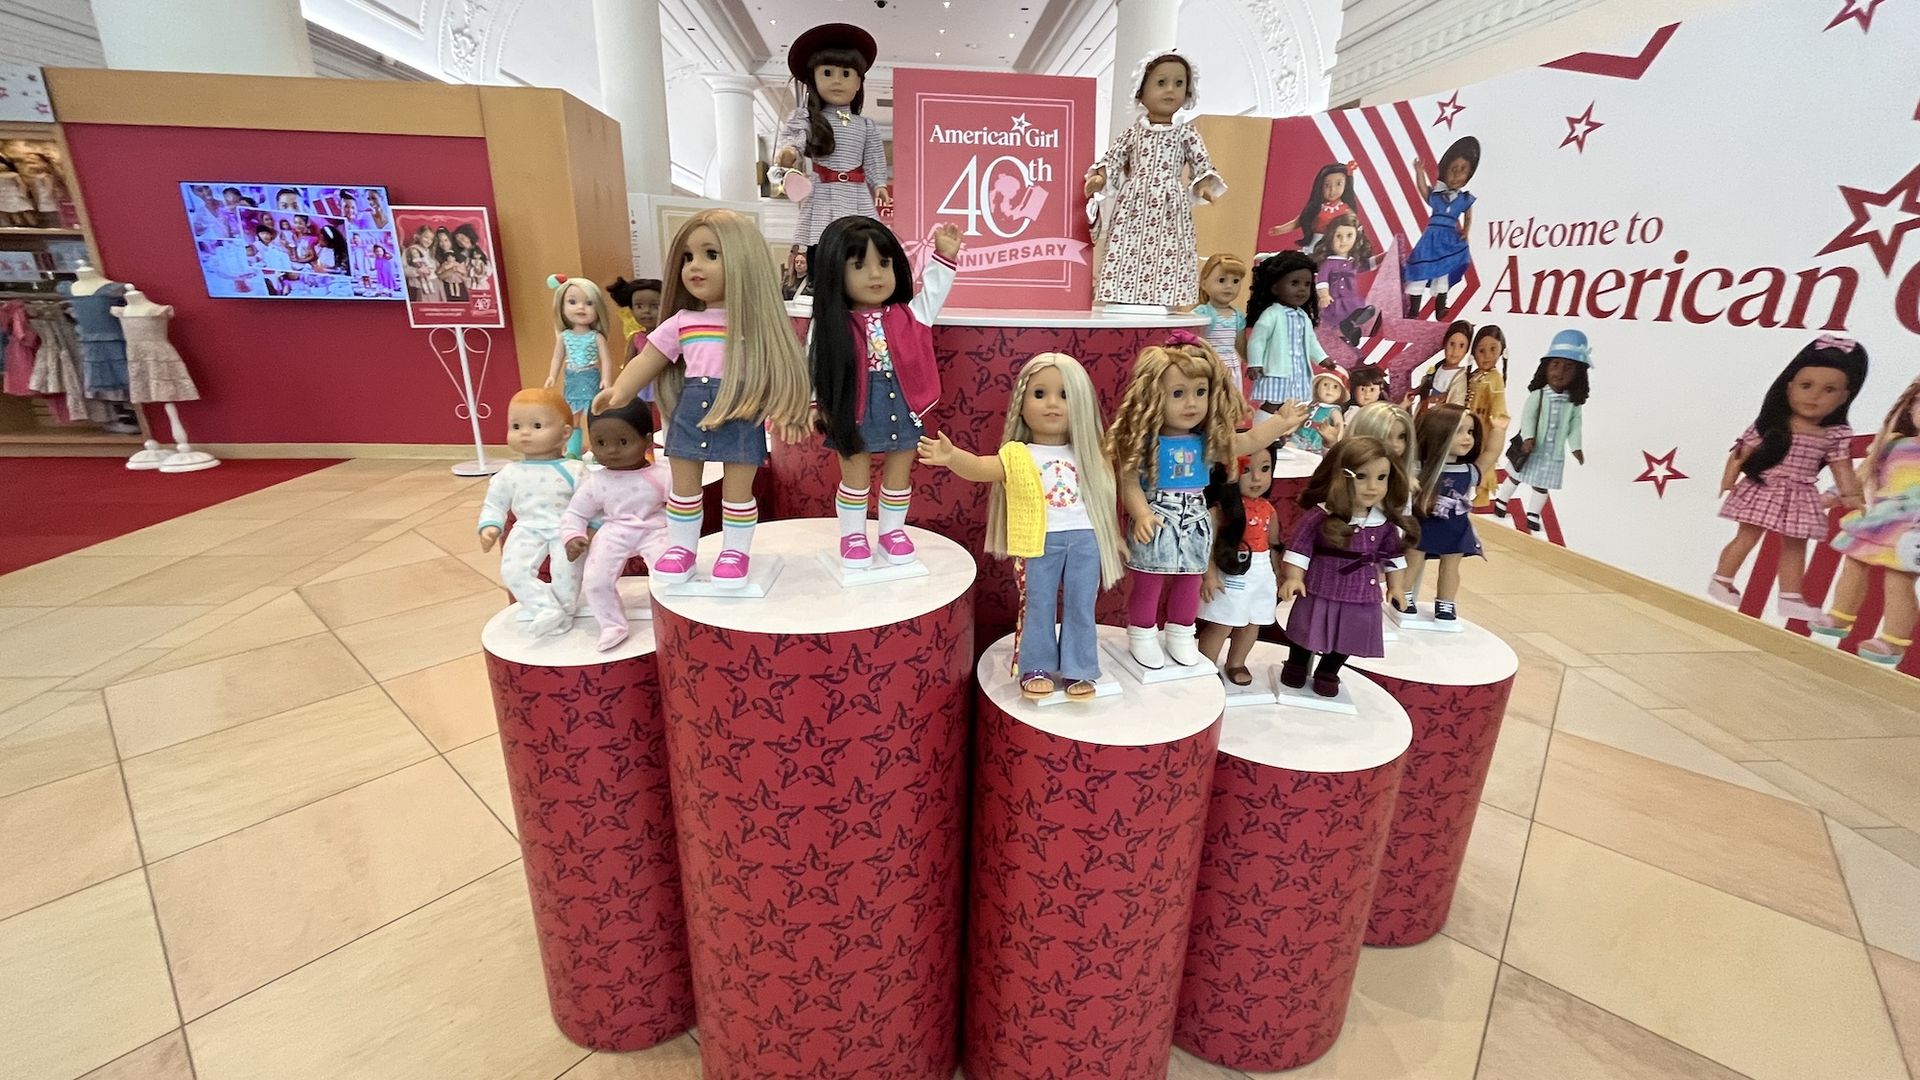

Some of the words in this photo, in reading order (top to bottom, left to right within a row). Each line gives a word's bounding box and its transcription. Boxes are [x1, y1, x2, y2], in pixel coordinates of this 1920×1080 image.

[929, 124, 1021, 147] American
[1025, 128, 1059, 148] Girl
[1487, 216, 1619, 249] Welcome
[1626, 211, 1664, 246] to
[954, 244, 1068, 267] NNIVERSARY
[1482, 249, 1860, 331] American
